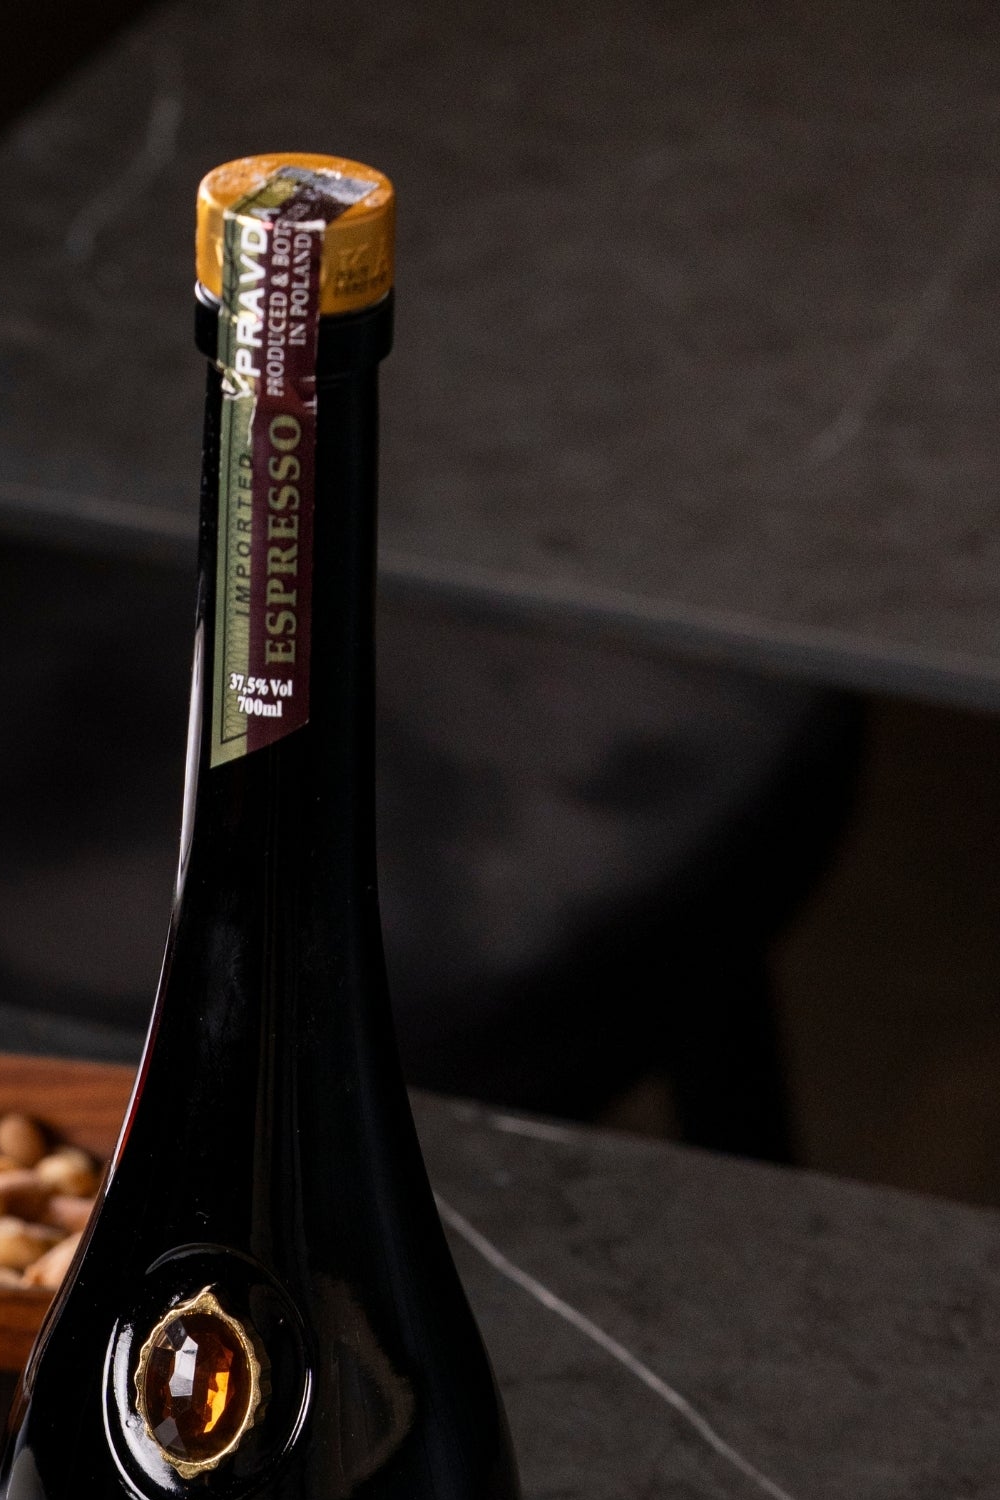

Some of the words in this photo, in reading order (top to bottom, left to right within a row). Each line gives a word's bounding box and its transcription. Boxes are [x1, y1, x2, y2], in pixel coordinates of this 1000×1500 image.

[271, 272, 290, 287] &
[290, 233, 312, 317] POLAND
[266, 291, 288, 397] PRODUCED
[288, 322, 307, 345] IN
[236, 452, 254, 617] IMPORTED
[265, 414, 301, 665] ESPRESSO
[229, 673, 269, 696] 37,5%
[270, 679, 293, 698] Vol
[237, 696, 283, 717] 700ml
